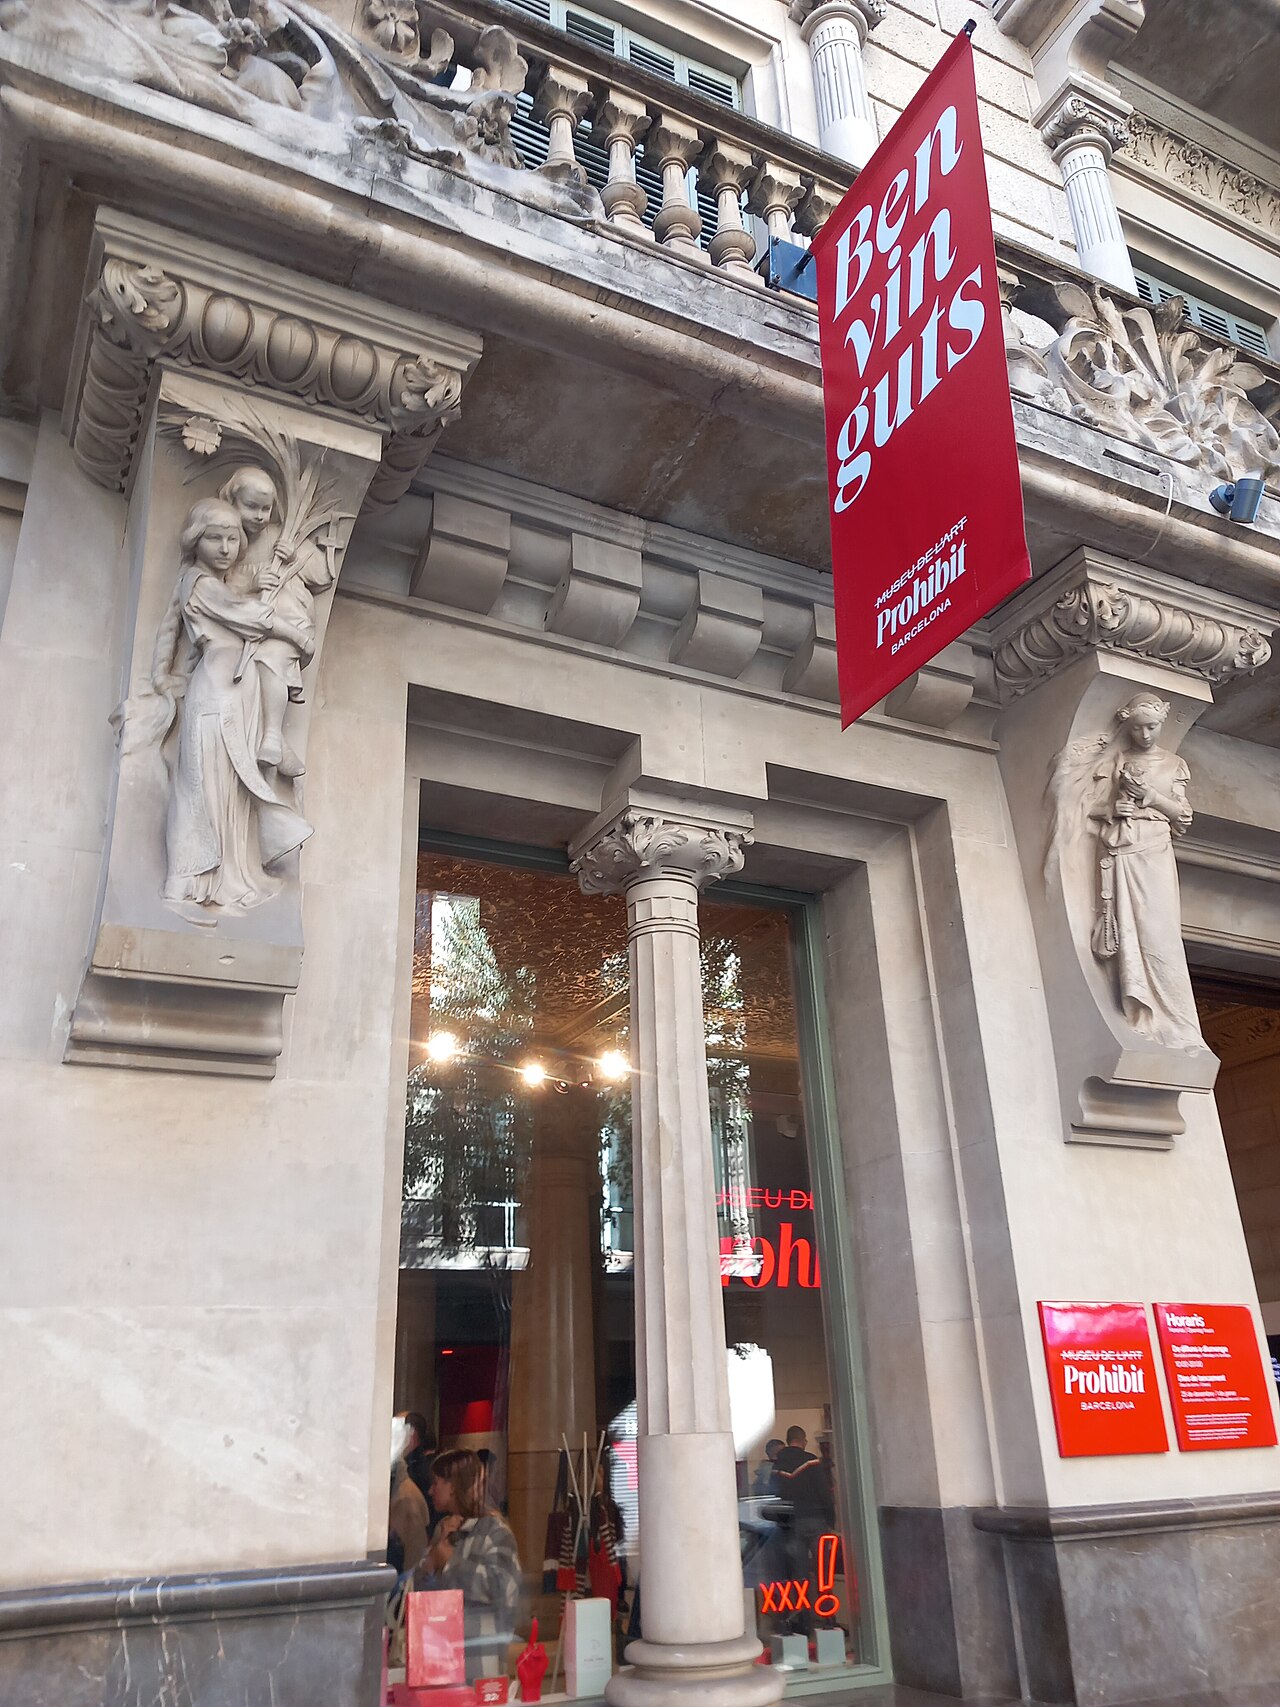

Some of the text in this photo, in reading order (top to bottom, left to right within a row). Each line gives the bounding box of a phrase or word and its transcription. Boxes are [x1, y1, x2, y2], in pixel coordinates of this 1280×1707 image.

[833, 105, 964, 327] Ben
[844, 208, 957, 378] vin
[833, 264, 985, 513] guts
[874, 564, 916, 609] MUSEU
[916, 547, 934, 571] DE
[876, 538, 967, 649] Prohibit
[891, 598, 952, 656] BARCELONA
[790, 1189, 814, 1210] D
[1063, 1364, 1145, 1394] Prohibit
[1080, 1401, 1135, 1411] BARCELONA
